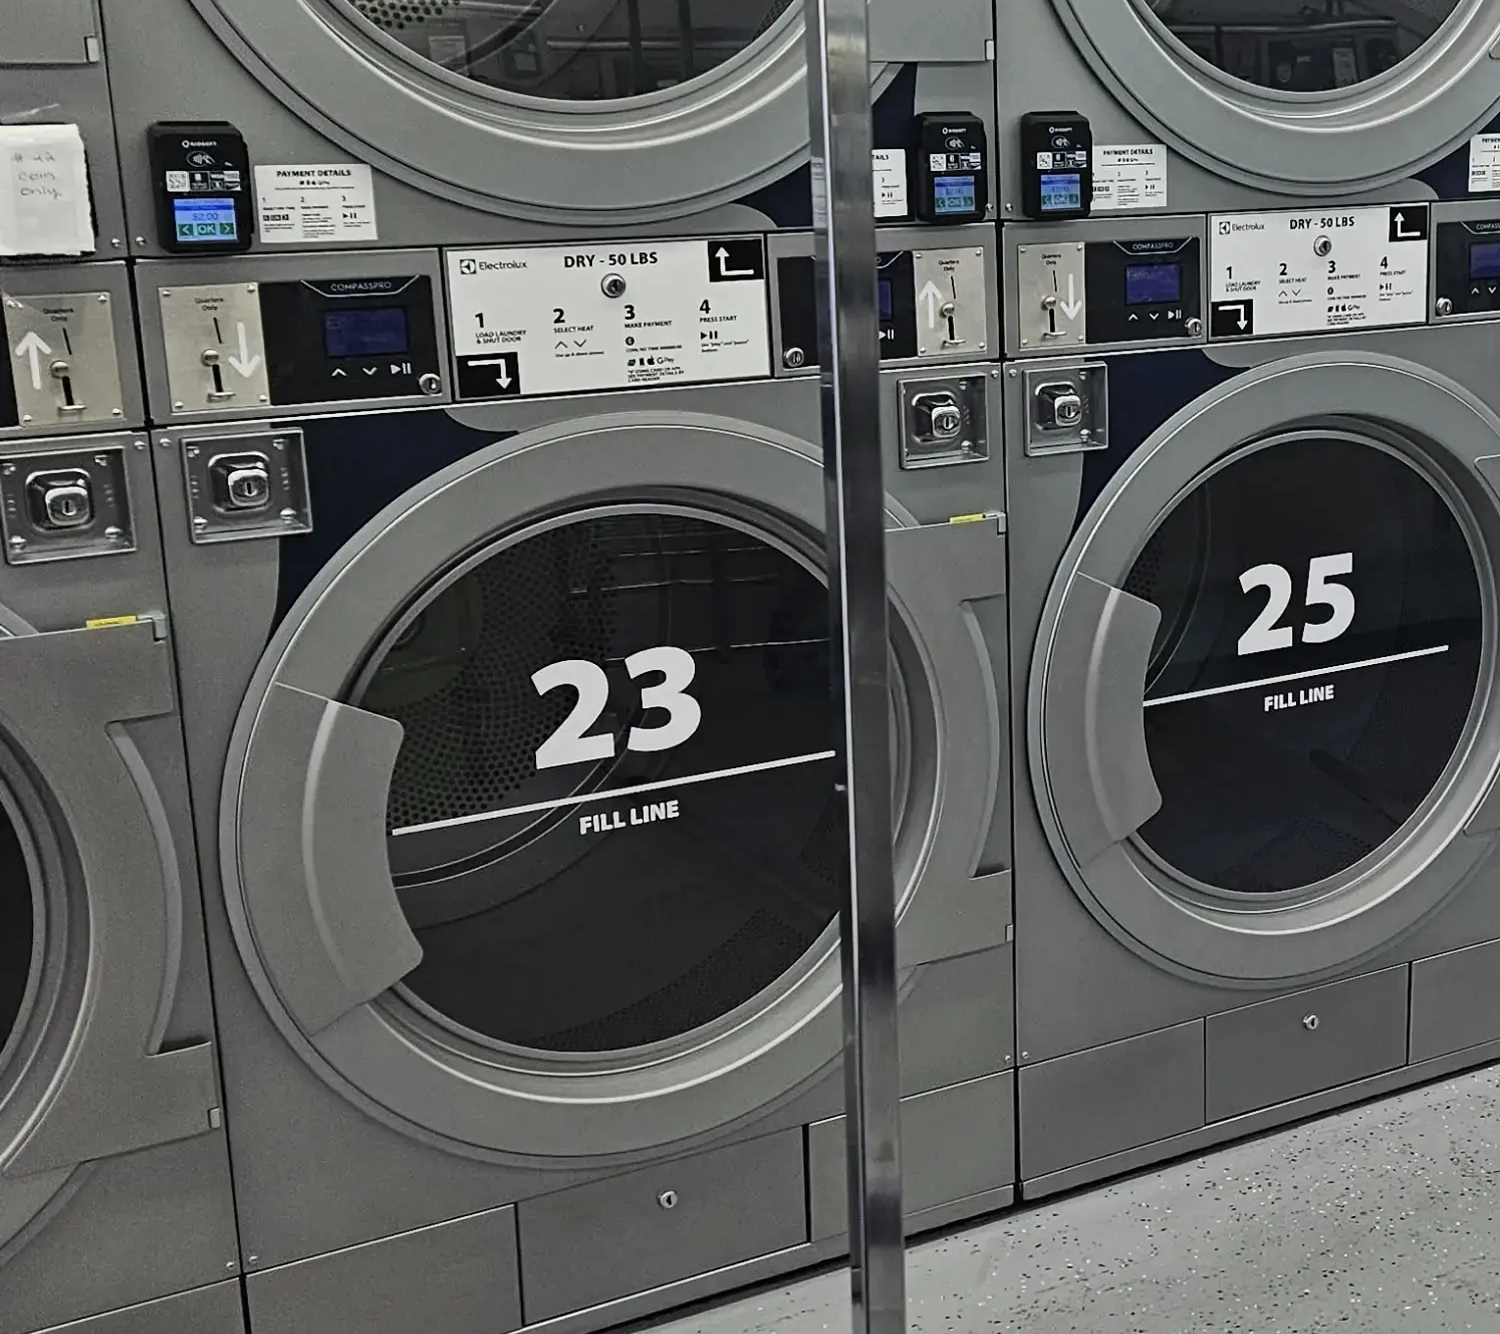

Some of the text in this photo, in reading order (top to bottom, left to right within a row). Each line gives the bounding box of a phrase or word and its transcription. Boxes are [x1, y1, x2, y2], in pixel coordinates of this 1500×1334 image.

[317, 169, 351, 177] DETAILS
[199, 226, 216, 234] OK
[1231, 222, 1265, 232] Electrolux
[1289, 218, 1312, 230] DRY
[1320, 217, 1333, 229] 50
[1335, 216, 1355, 228] LBS
[1132, 242, 1174, 250] COMPASSPRO
[478, 260, 528, 271] Electrolux
[564, 254, 596, 268] DRY
[608, 253, 627, 266] 50
[630, 251, 658, 265] LBS
[1225, 256, 1388, 280] 1 2 3 4
[330, 281, 392, 291] COMPASSPRO
[474, 299, 711, 329] 1 2 3 4
[495, 329, 527, 337] LAUNDRY
[1237, 552, 1355, 656] 25
[1264, 684, 1334, 712] FILL LINE
[531, 646, 701, 770] 23
[579, 800, 679, 835] FILL LINE
